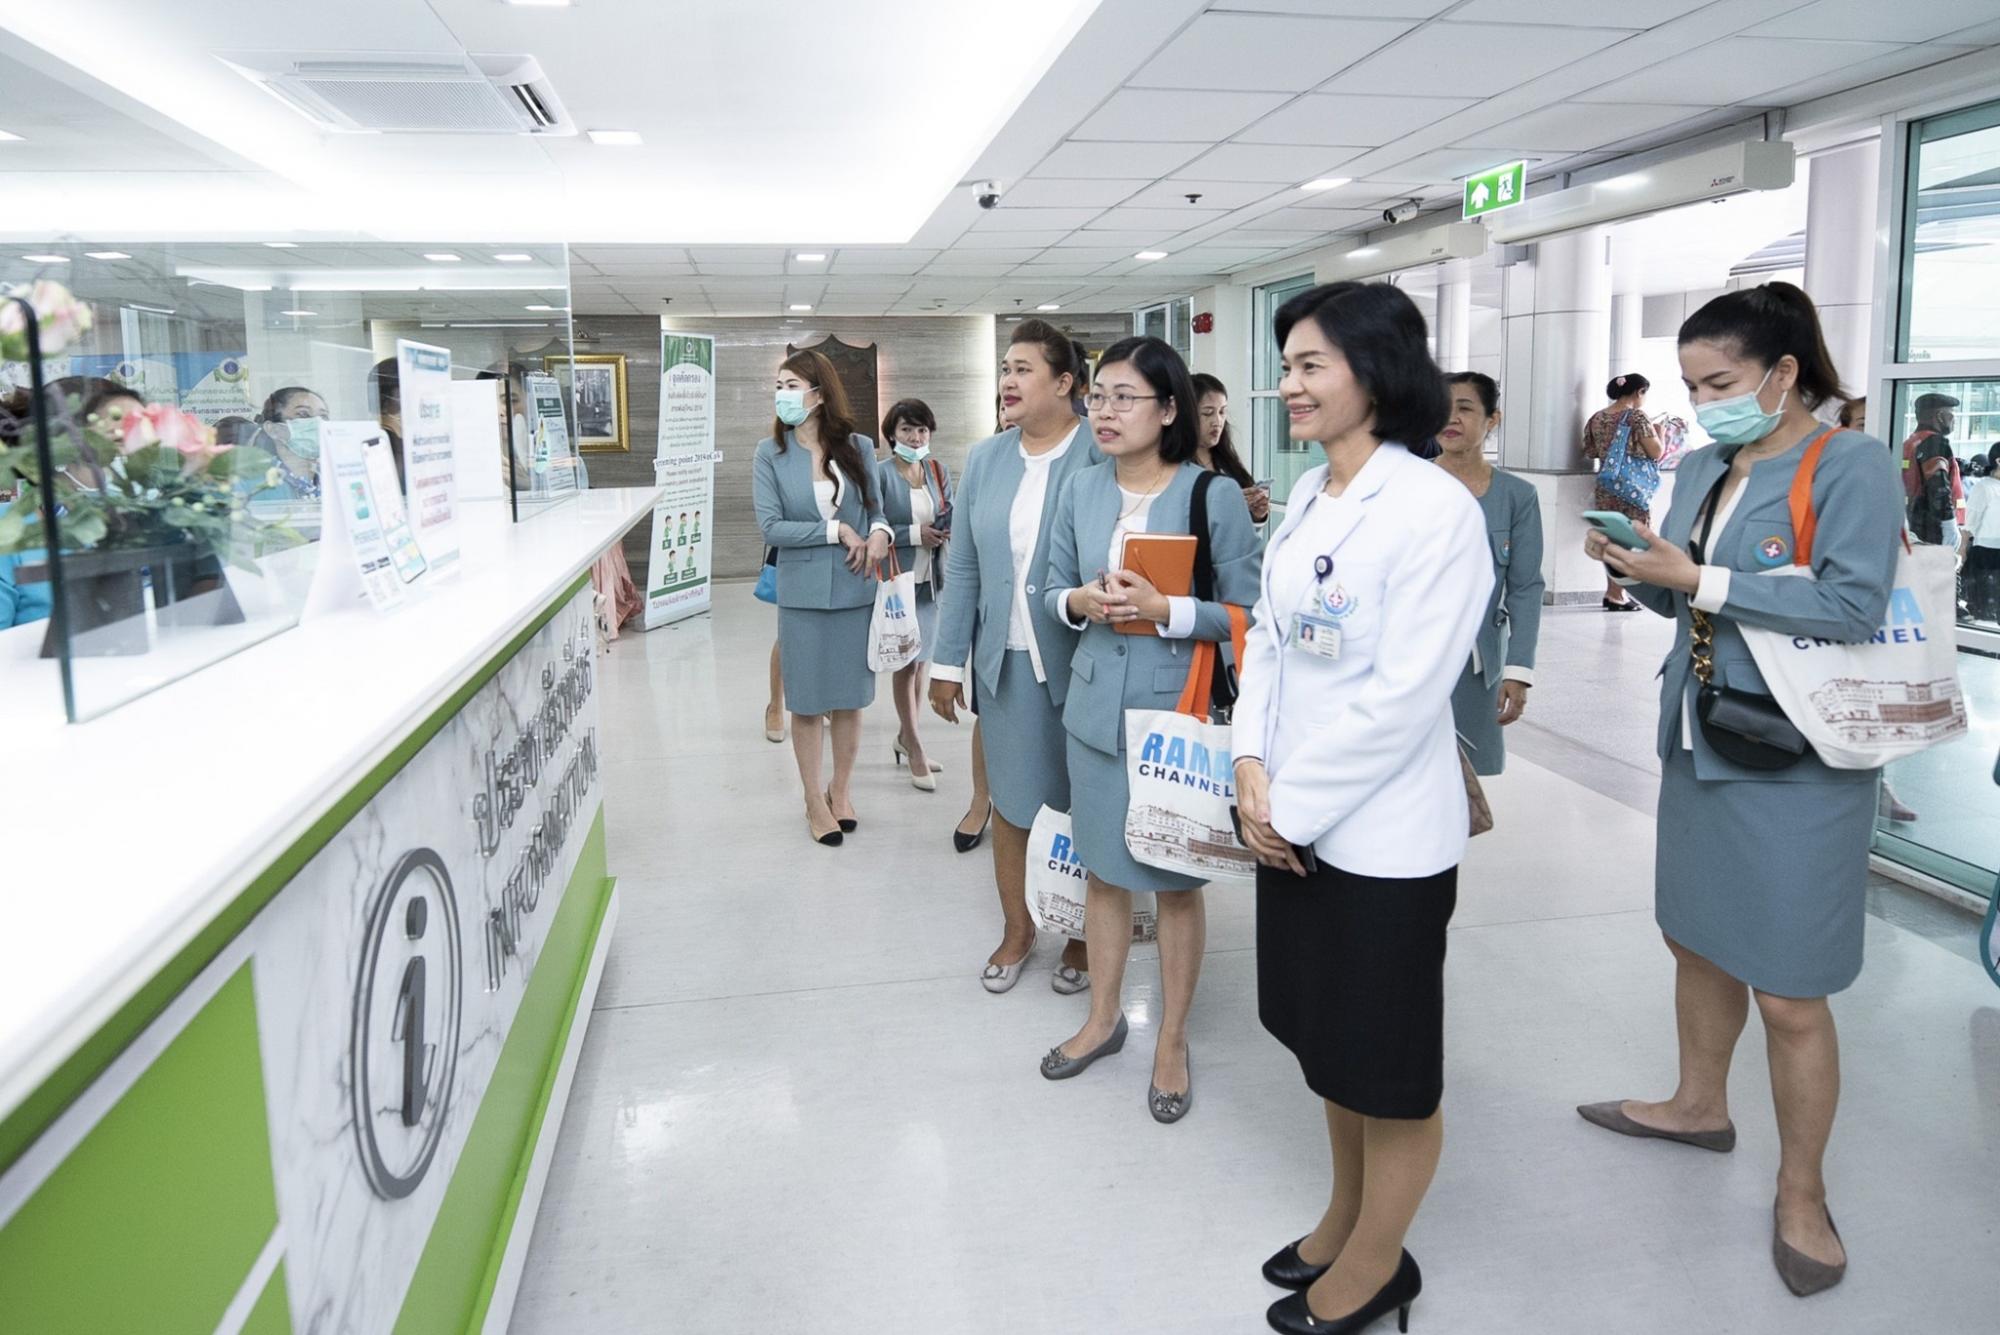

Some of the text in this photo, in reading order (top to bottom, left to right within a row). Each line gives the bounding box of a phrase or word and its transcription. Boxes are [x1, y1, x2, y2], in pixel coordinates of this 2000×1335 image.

[1885, 587, 1925, 625] A
[1793, 627, 1928, 650] CHNEL
[1141, 732, 1234, 784] RAMA
[1139, 764, 1234, 798] CHANNEL
[484, 726, 599, 993] INFORMATION
[1050, 833, 1081, 866] R
[1048, 860, 1088, 881] CHA
